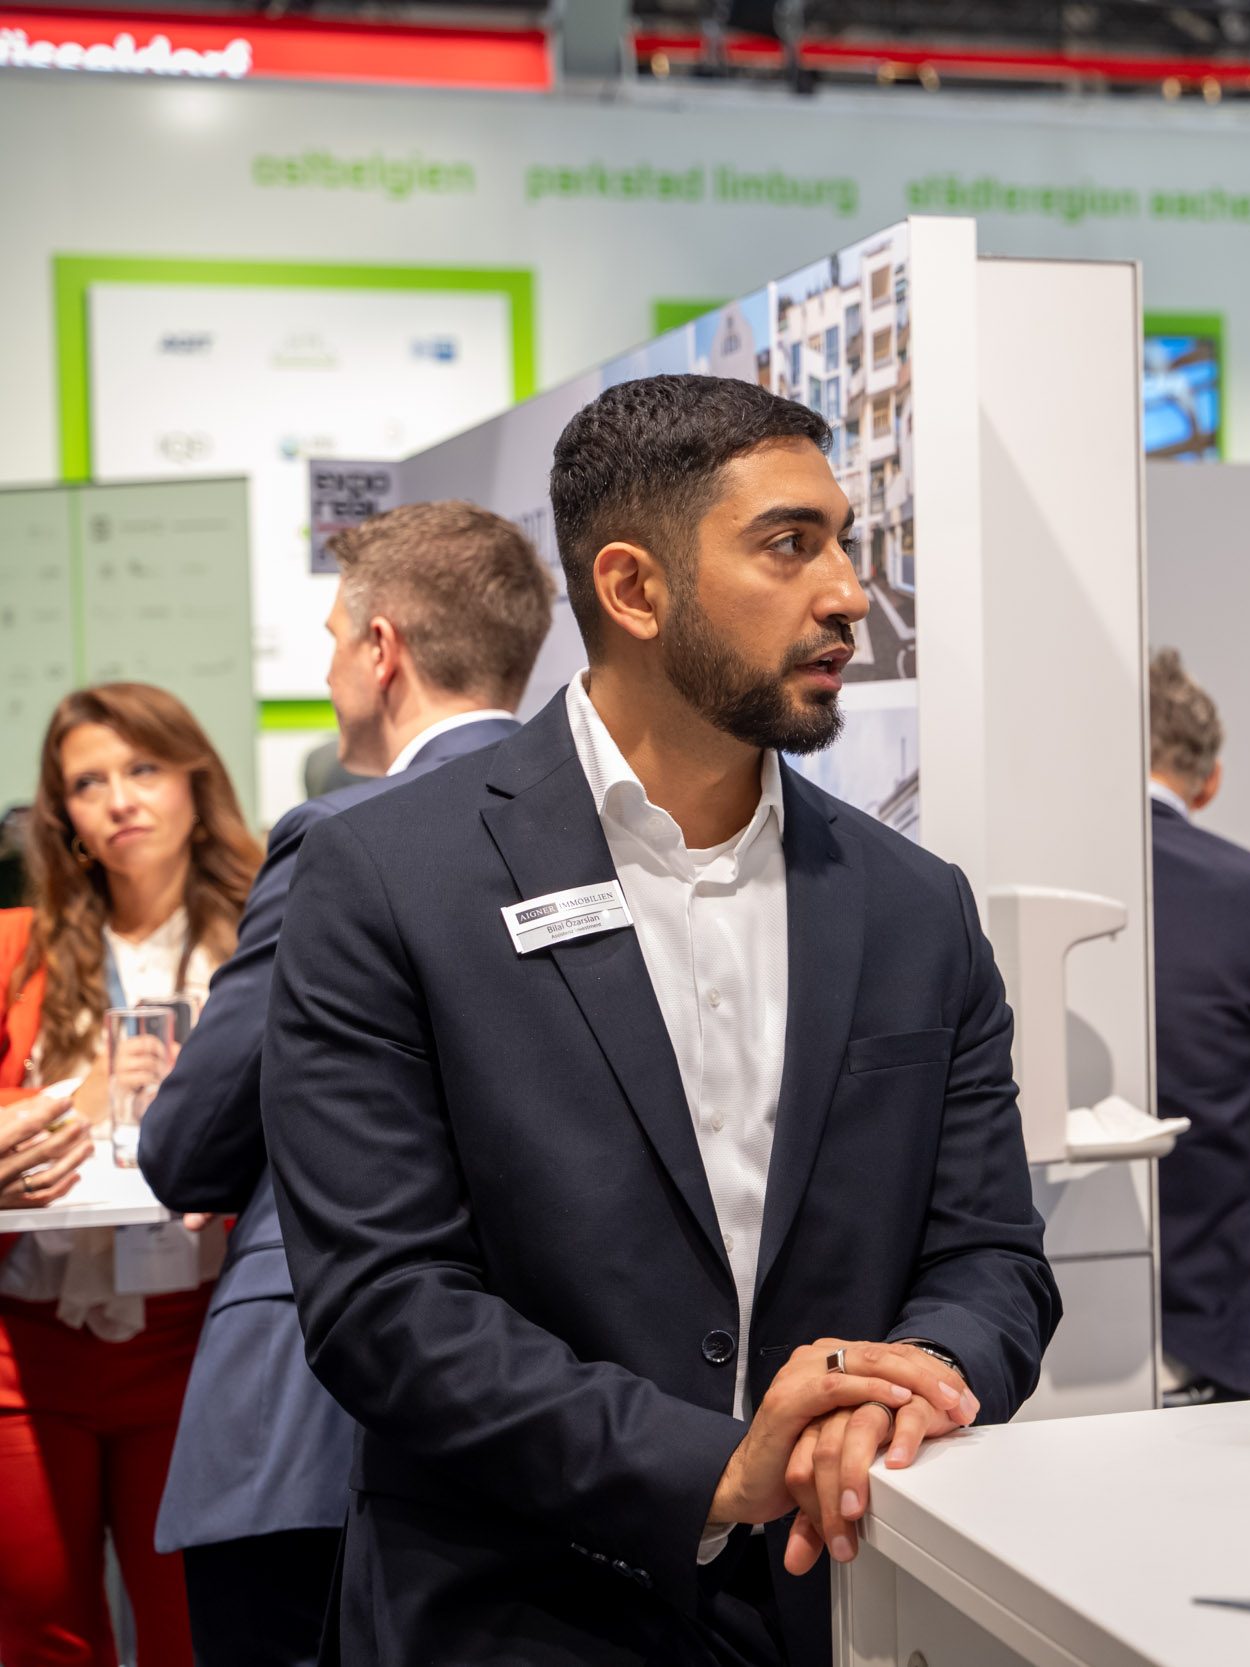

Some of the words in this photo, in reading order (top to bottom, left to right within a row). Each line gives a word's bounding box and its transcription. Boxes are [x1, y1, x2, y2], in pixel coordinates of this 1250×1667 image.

[252, 154, 475, 200] ostbelgien
[526, 162, 704, 205] parkstad
[713, 165, 859, 217] limburg
[906, 174, 1139, 225] städteregion
[315, 472, 390, 498] expo
[520, 905, 556, 921] AIGNER
[559, 891, 613, 909] IMMOBILIEN
[546, 922, 564, 934] Bilal
[565, 914, 600, 928] Özarslan
